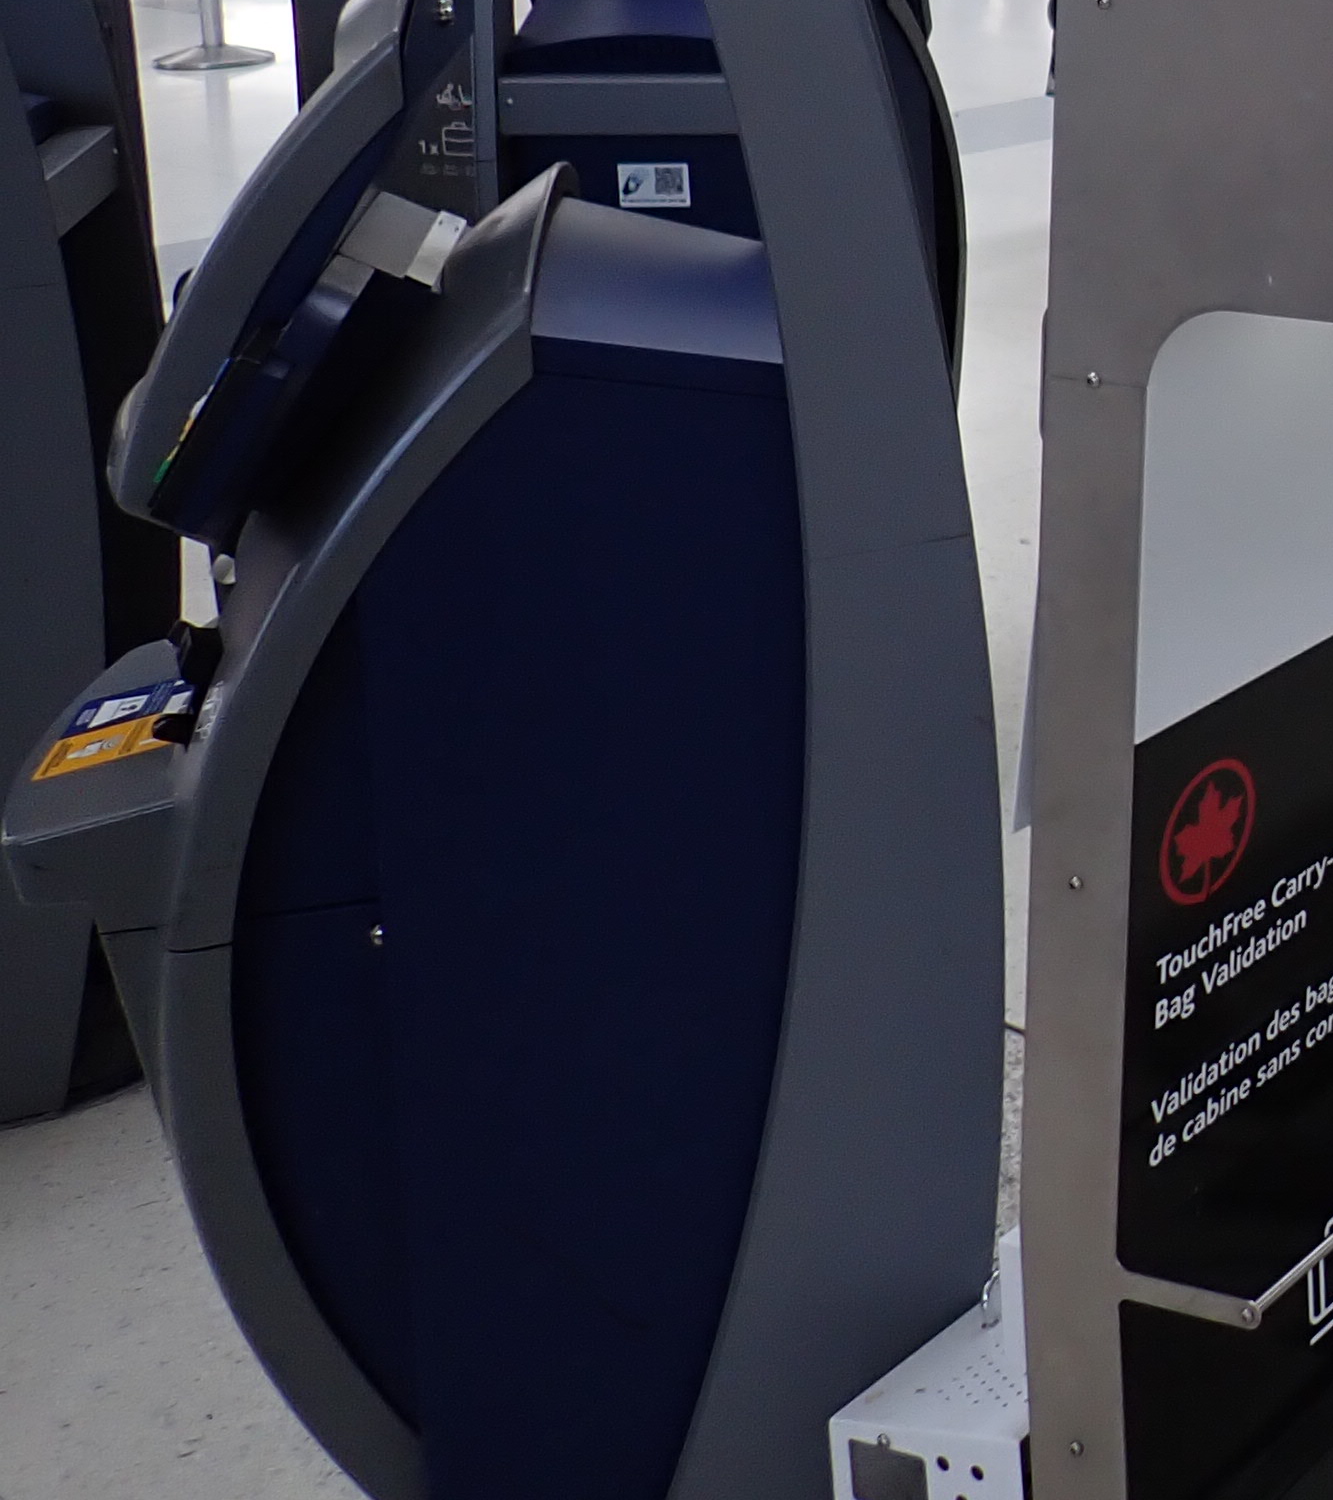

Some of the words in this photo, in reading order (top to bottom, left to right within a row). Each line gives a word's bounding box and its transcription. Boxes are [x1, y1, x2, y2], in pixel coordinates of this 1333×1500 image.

[1153, 986, 1196, 1030] Bag
[1200, 908, 1308, 996] Validation
[1156, 898, 1266, 985] TouchFree
[1148, 1131, 1177, 1169] de
[1181, 1081, 1251, 1142] cabine
[1255, 1046, 1301, 1089] sans
[1150, 1031, 1262, 1125] Validation
[1265, 1002, 1301, 1041] des
